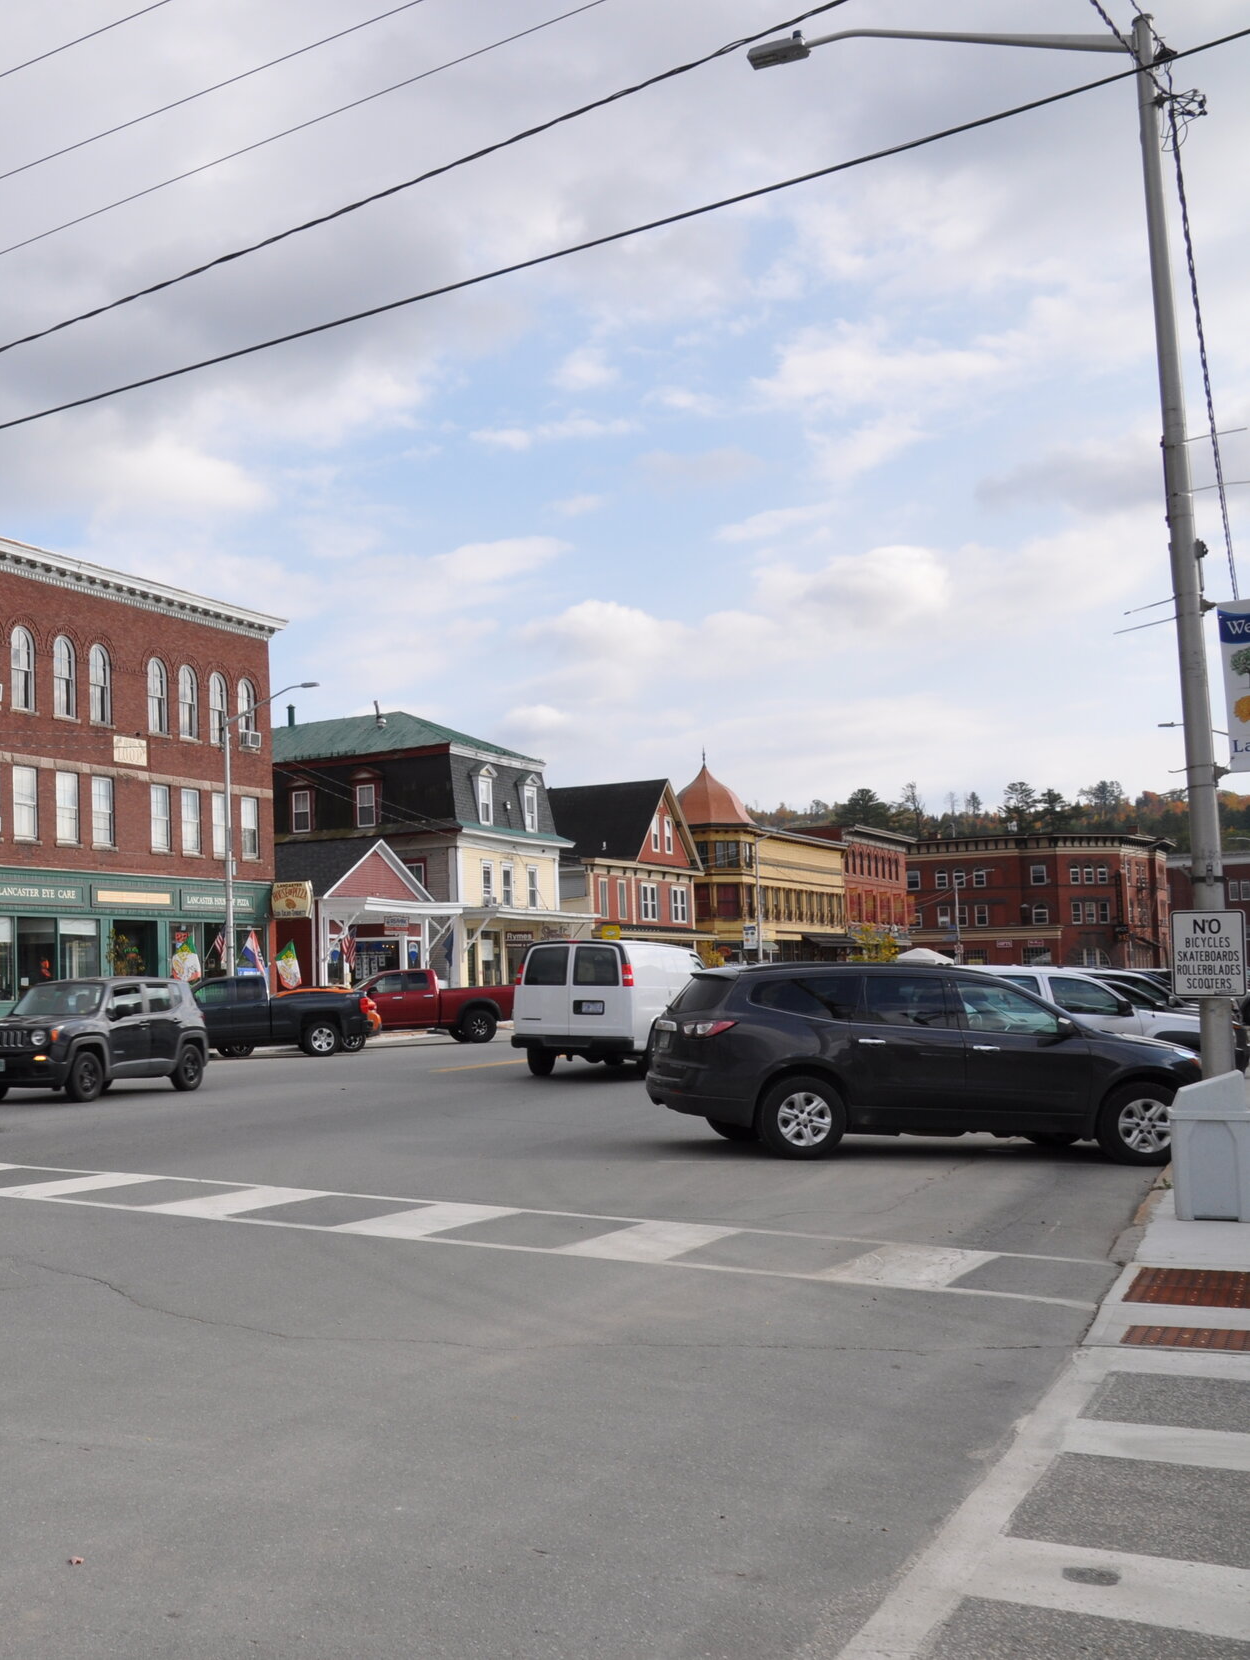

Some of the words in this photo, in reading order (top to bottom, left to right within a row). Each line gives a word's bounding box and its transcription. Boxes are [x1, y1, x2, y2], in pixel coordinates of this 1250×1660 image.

[41, 888, 55, 898] EYE
[57, 889, 76, 899] CARE
[186, 895, 213, 905] LANCASTER
[214, 897, 226, 906] HOUS
[236, 898, 250, 906] PIZZA
[1193, 918, 1221, 934] NO
[506, 932, 532, 940] Rymes
[1185, 936, 1231, 948] BICYCLES
[1177, 950, 1240, 962] SKATEBOARDS
[1176, 964, 1241, 976] ROLLERBLADES
[1186, 977, 1232, 989] SCOOTERS
